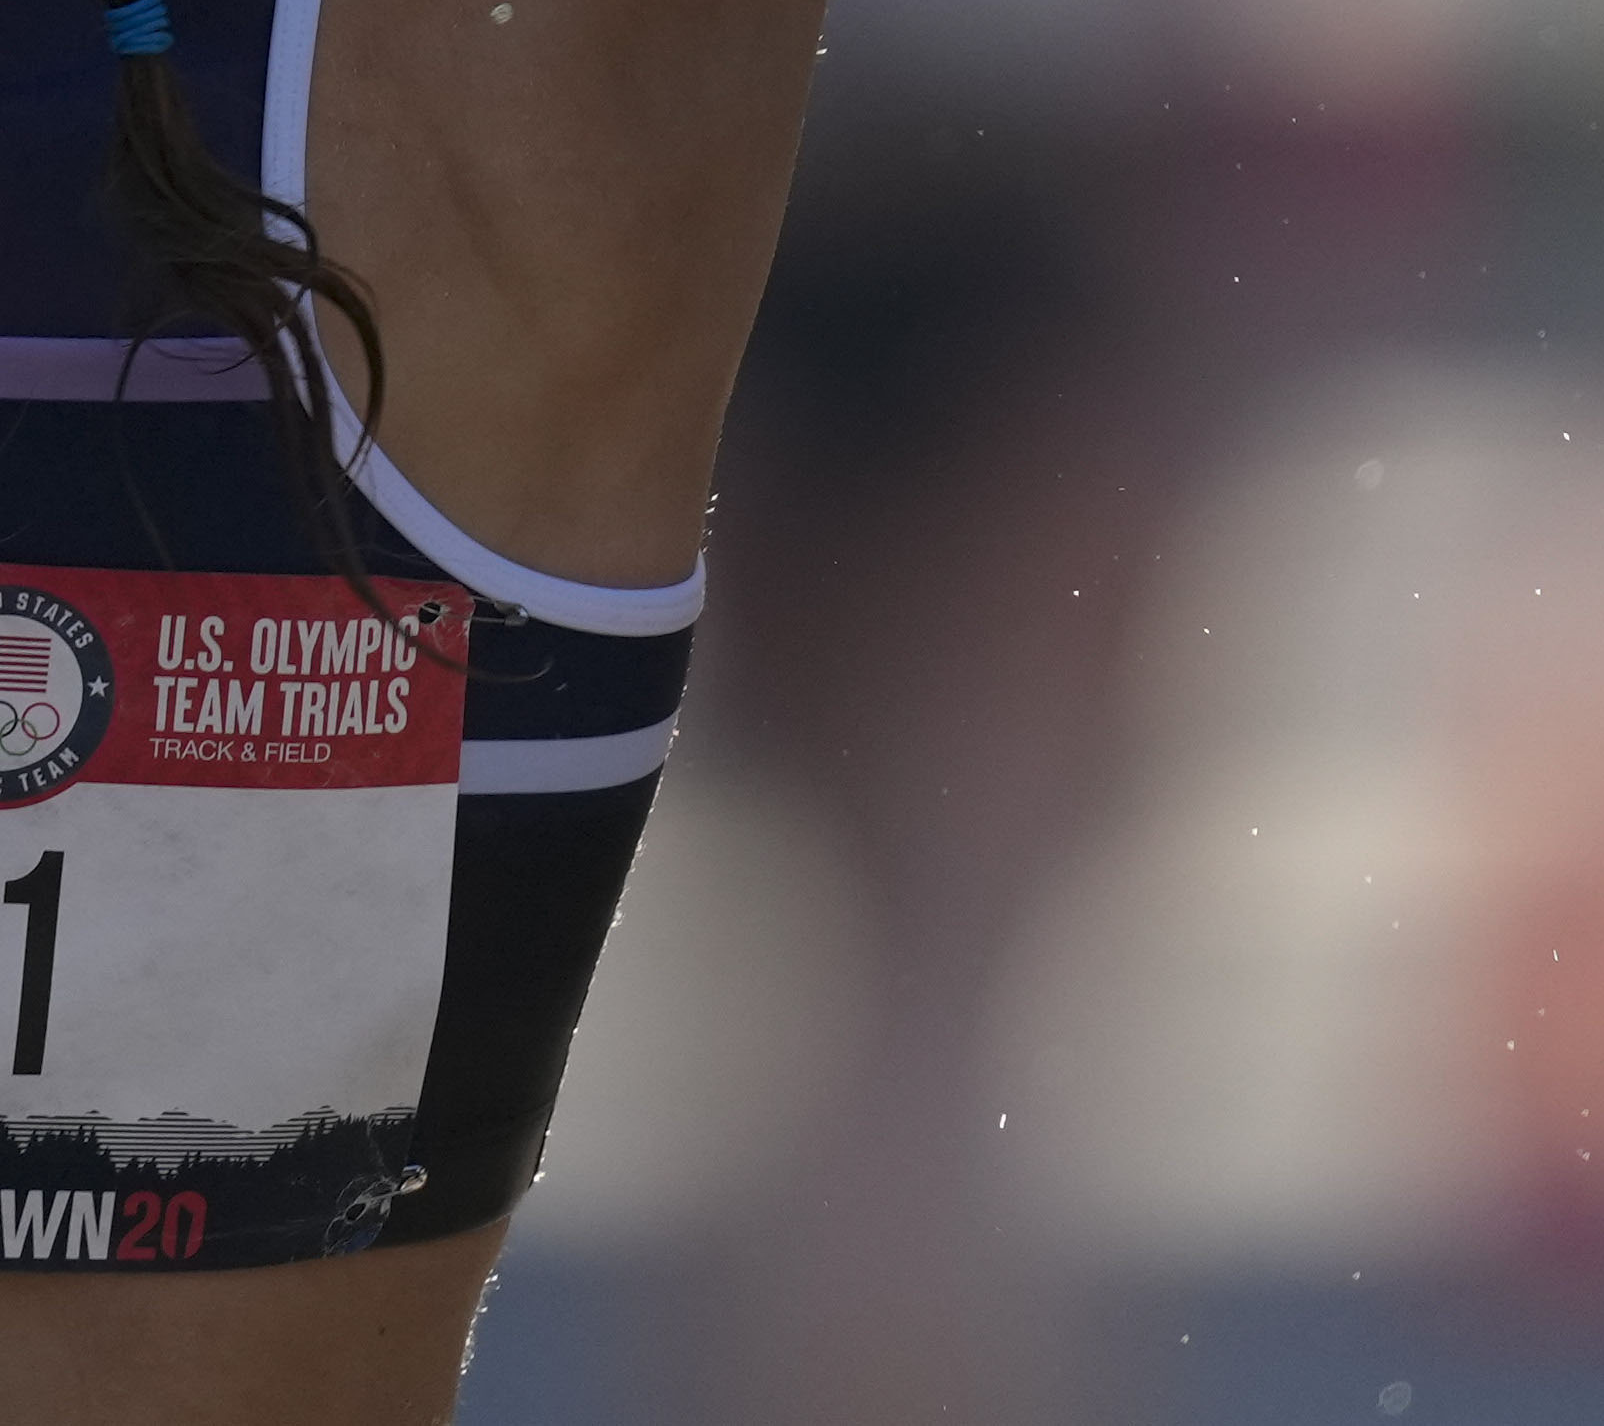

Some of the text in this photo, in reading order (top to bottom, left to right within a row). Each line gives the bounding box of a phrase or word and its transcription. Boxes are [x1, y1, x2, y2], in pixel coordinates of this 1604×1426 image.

[16, 592, 94, 649] STATES
[157, 614, 420, 676] U.S. OLYMPIC
[153, 675, 410, 737] TEAM TRIALS
[18, 746, 81, 792] TEAM
[149, 737, 332, 763] TRACK & FIELD
